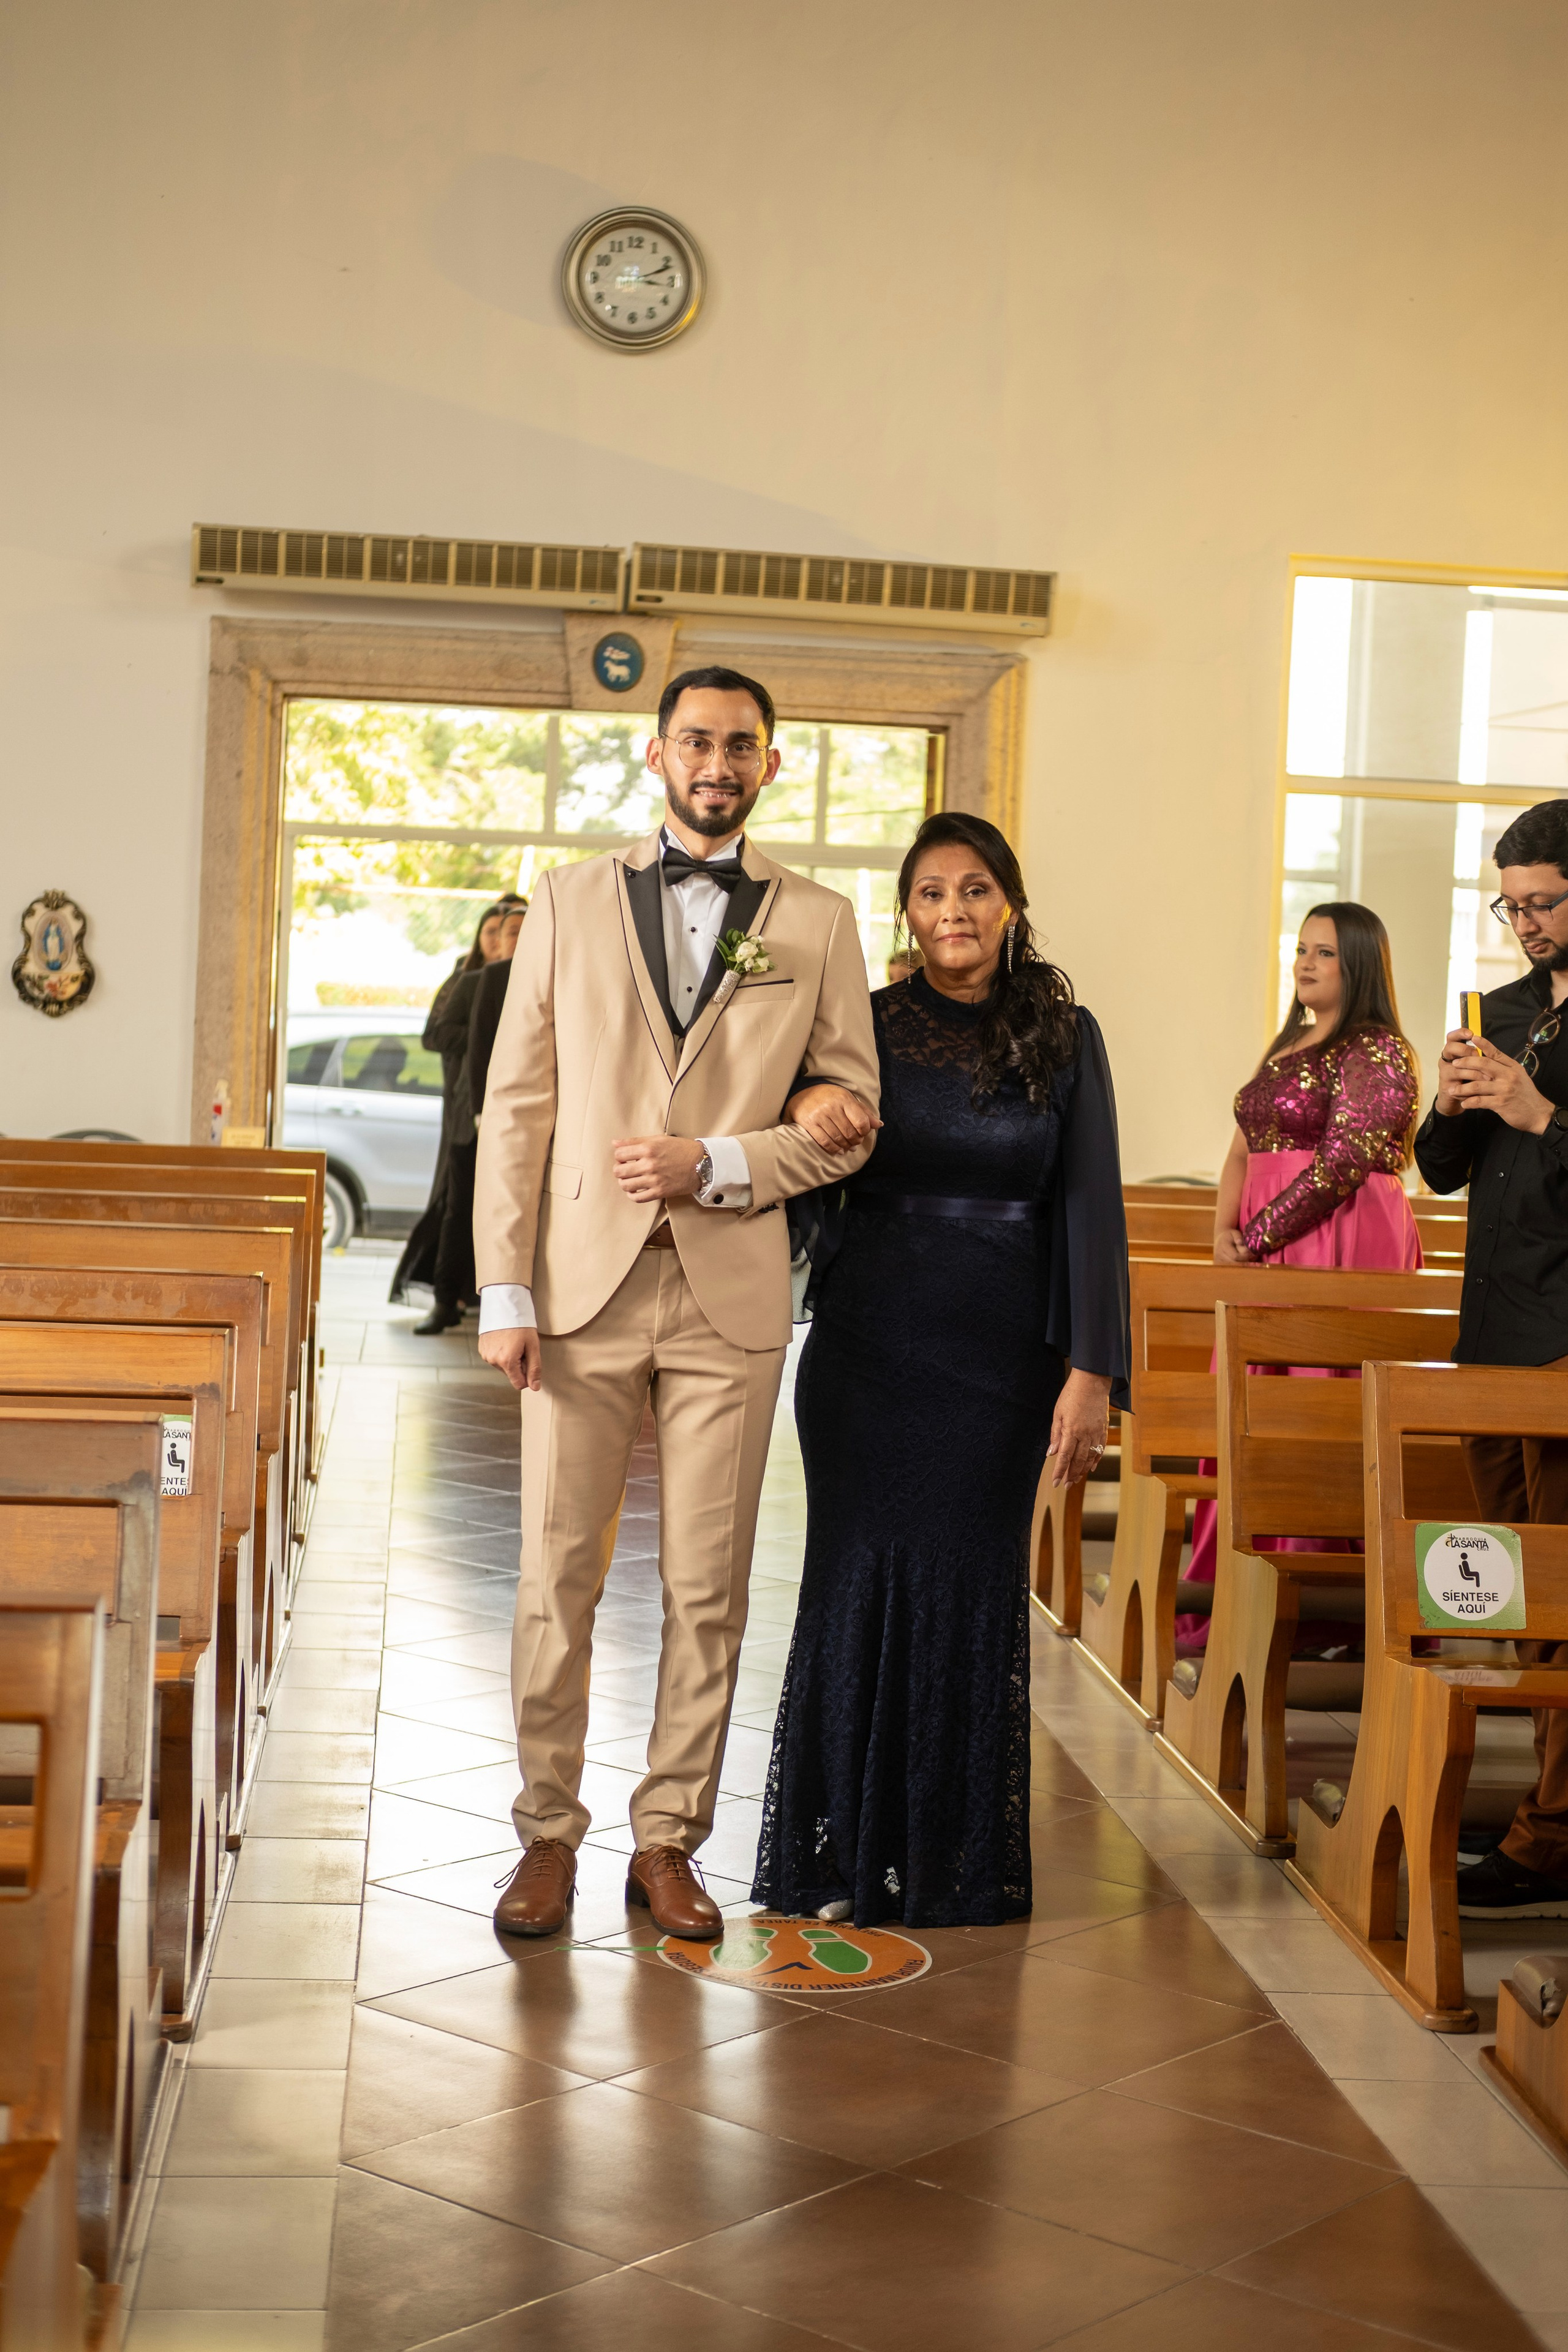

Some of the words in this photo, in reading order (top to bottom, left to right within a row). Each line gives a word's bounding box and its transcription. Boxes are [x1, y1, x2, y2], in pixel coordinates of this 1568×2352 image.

[609, 240, 624, 253] 11
[627, 236, 645, 249] 12
[651, 242, 658, 254] 1
[596, 254, 612, 266] 10
[662, 256, 672, 268] 2
[590, 271, 600, 284] 9
[667, 276, 675, 288] 3
[594, 292, 605, 304] 8
[659, 295, 669, 306] 4
[611, 305, 619, 317] 7
[646, 306, 657, 319] 5
[627, 311, 638, 325] 6
[160, 1477, 189, 1485] ENTE
[162, 1486, 187, 1496] AQUÍ
[1442, 1589, 1499, 1602] SÍENTESE
[1457, 1602, 1486, 1614] AQUÍ
[825, 1922, 885, 1938] PREVENIR
[666, 1951, 707, 1973] SEGURA
[893, 1959, 924, 1977] FAVOR
[808, 1974, 902, 1991] MANTENER
